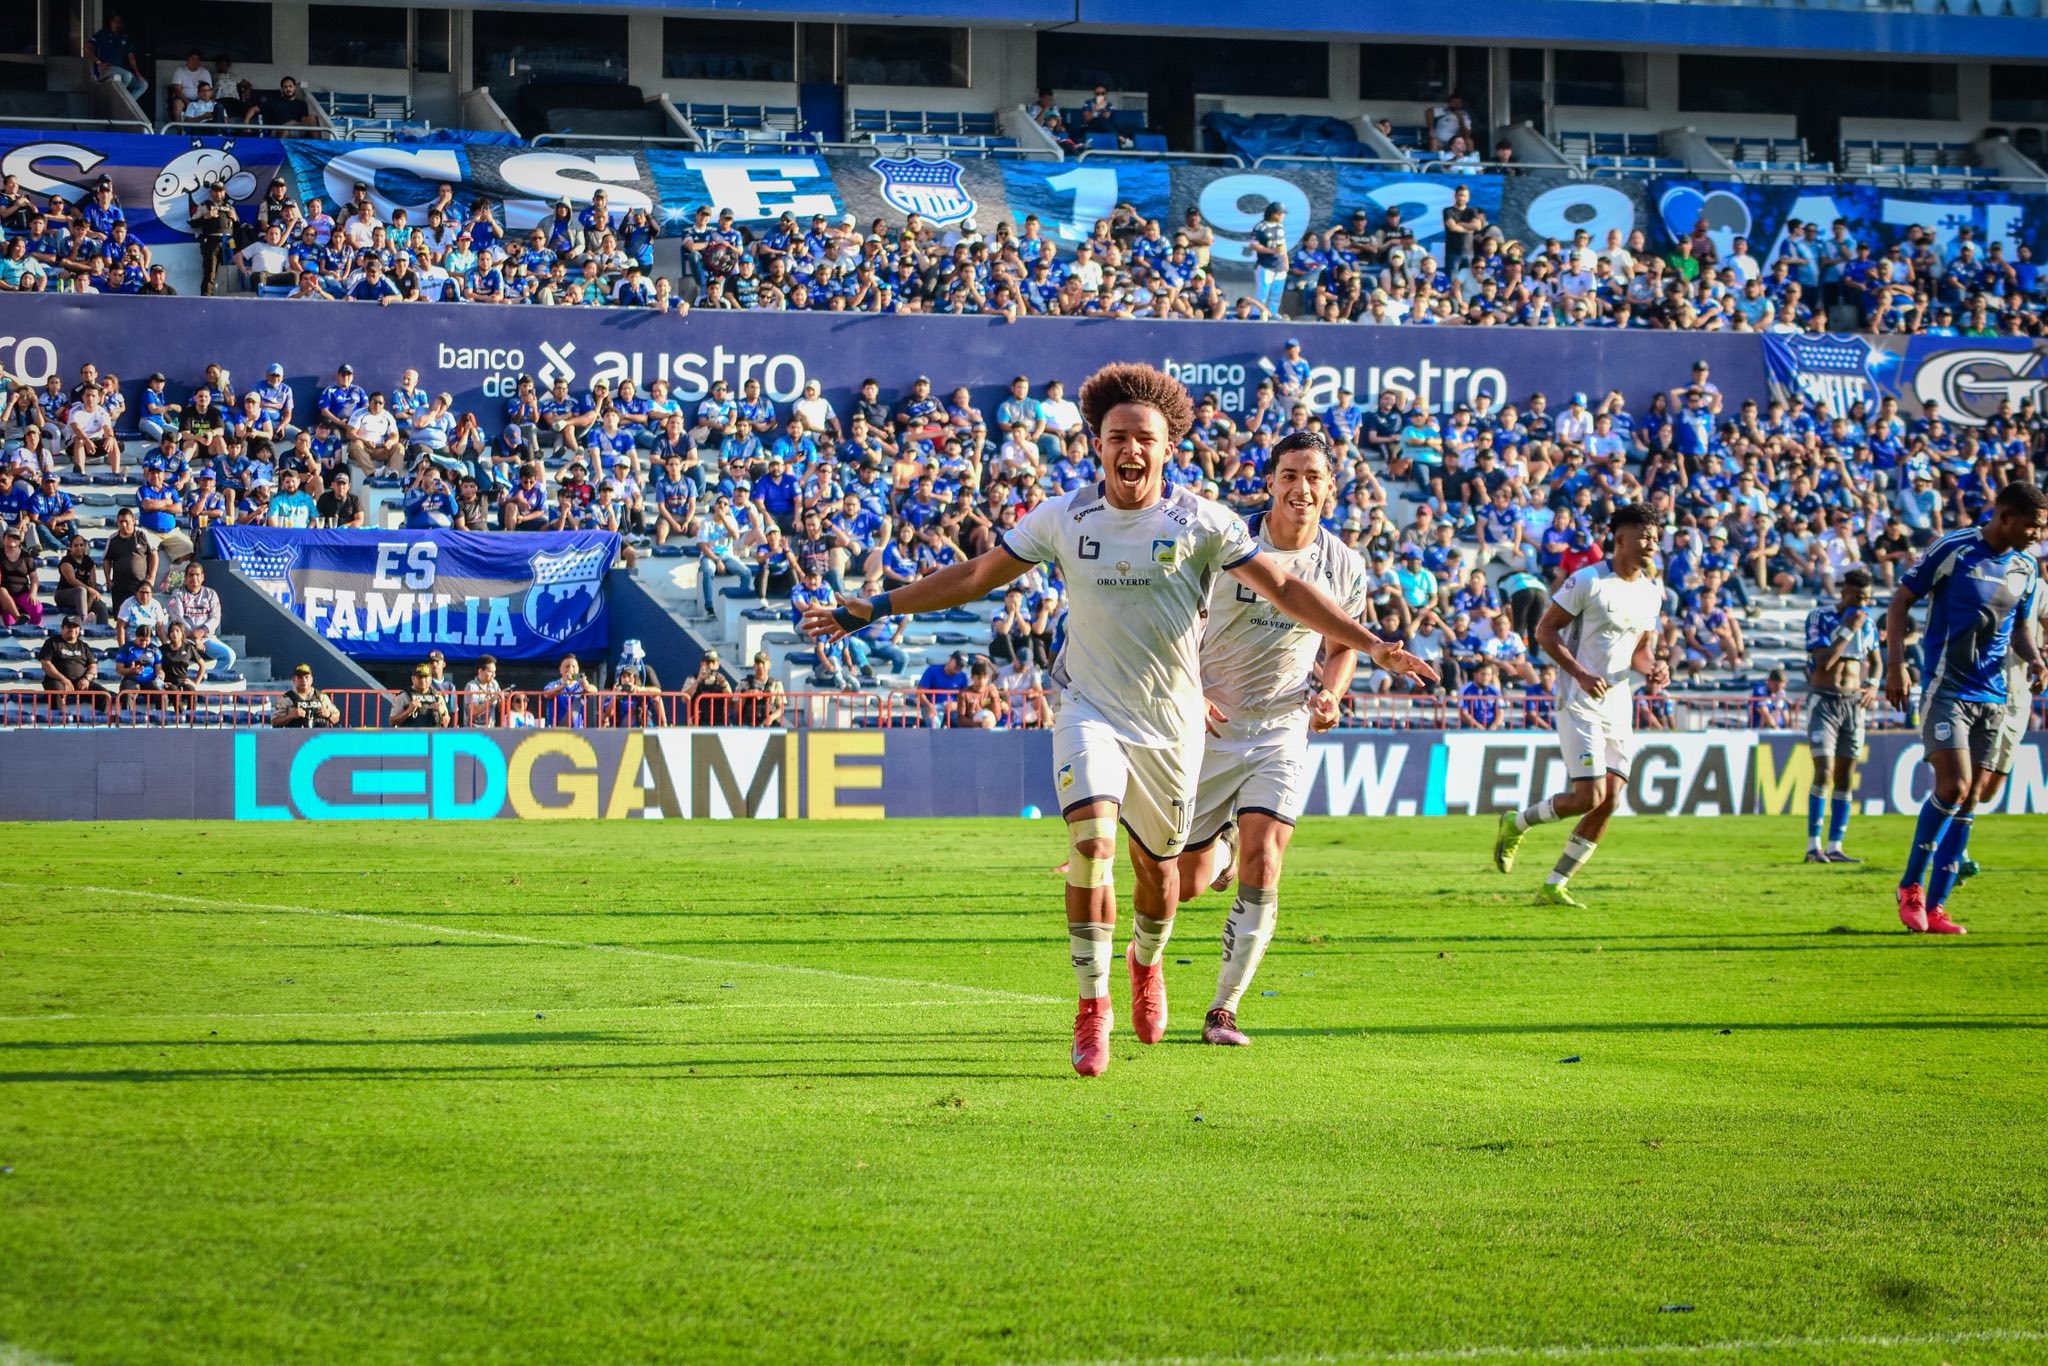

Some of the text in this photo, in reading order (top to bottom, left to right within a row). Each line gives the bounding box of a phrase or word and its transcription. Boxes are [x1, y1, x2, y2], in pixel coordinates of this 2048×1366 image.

[323, 147, 837, 230] CSE
[439, 343, 805, 403] banco austro
[1164, 359, 1507, 416] banco austro
[373, 541, 438, 590] ES
[1097, 578, 1151, 586] ORO VERDE
[303, 587, 517, 646] FAMILIA
[1250, 618, 1268, 627] ORO
[234, 732, 885, 820] LEDGAME
